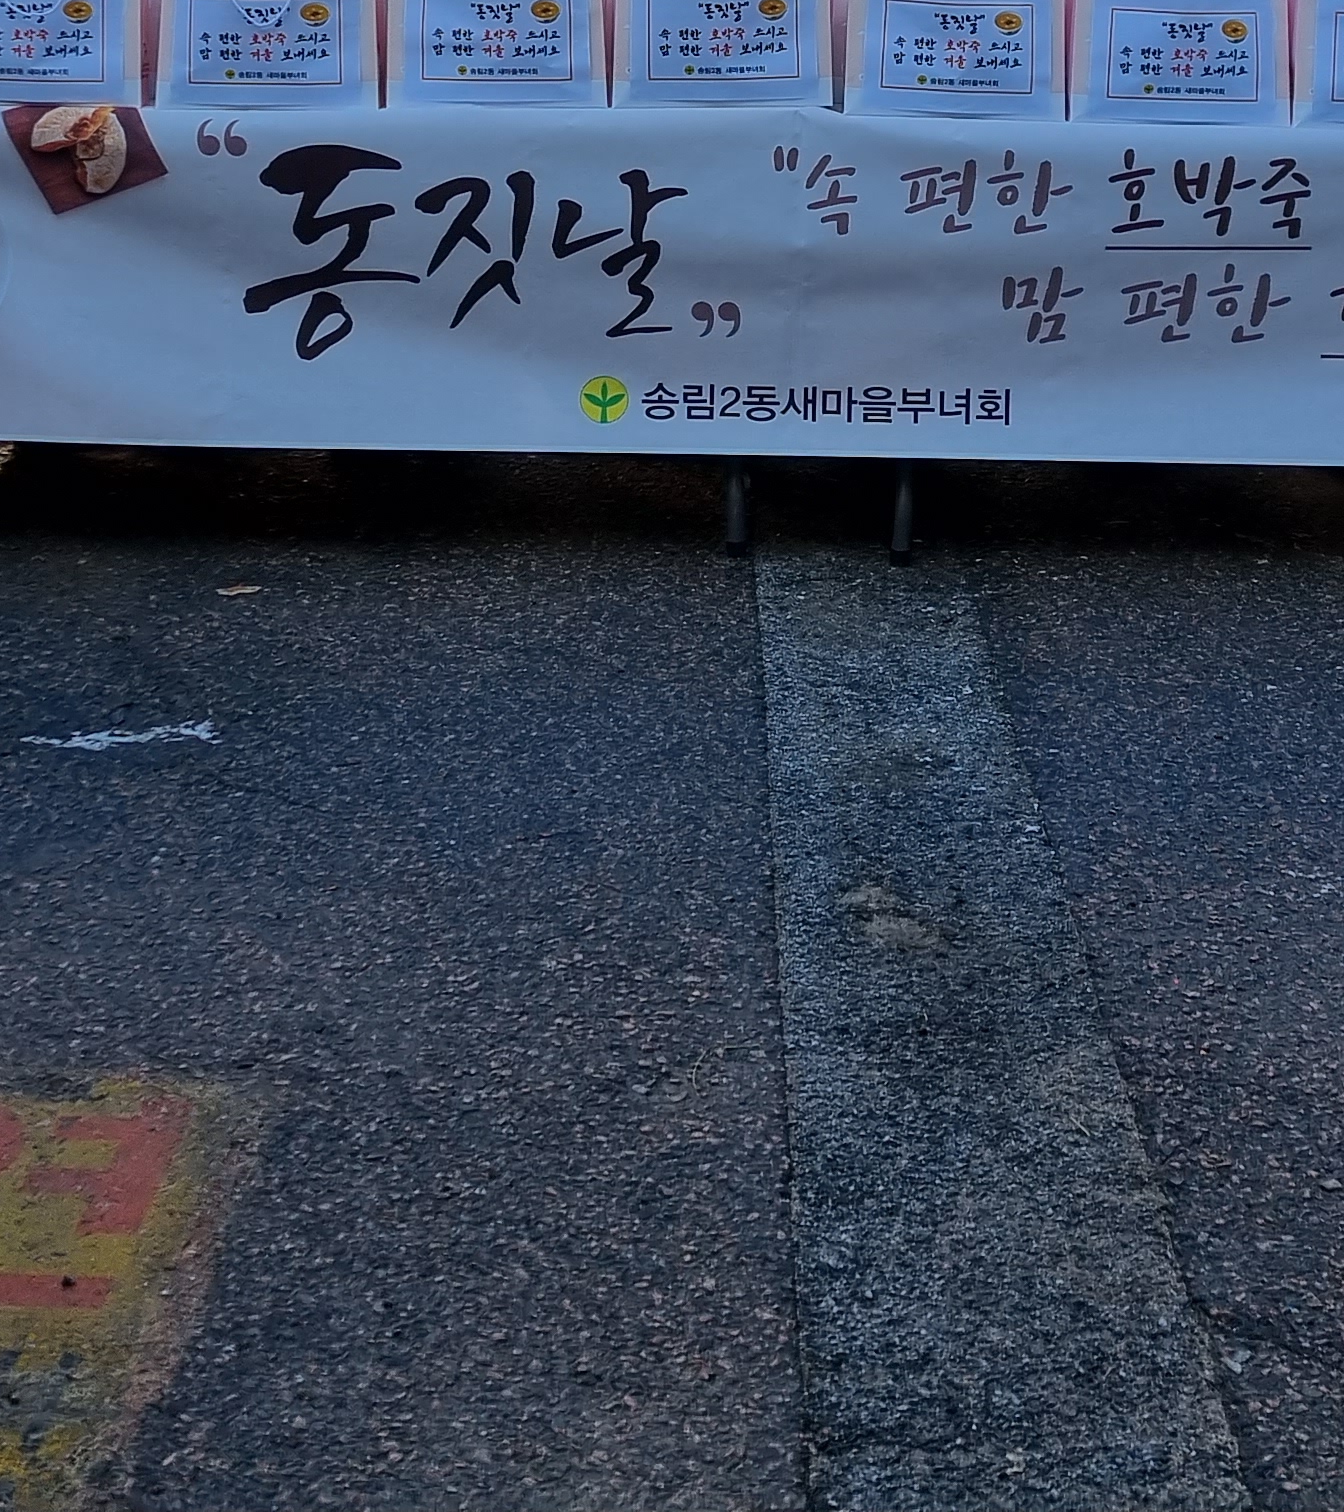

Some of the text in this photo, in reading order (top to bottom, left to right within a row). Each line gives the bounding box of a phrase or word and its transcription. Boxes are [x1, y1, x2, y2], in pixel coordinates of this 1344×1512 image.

[900, 150, 1073, 235] 편한
[1106, 148, 1315, 244] 호박죽
[1001, 267, 1085, 345] 맘
[1122, 263, 1291, 345] 편한
[639, 381, 1015, 426] 송림2동새마을부녀회
